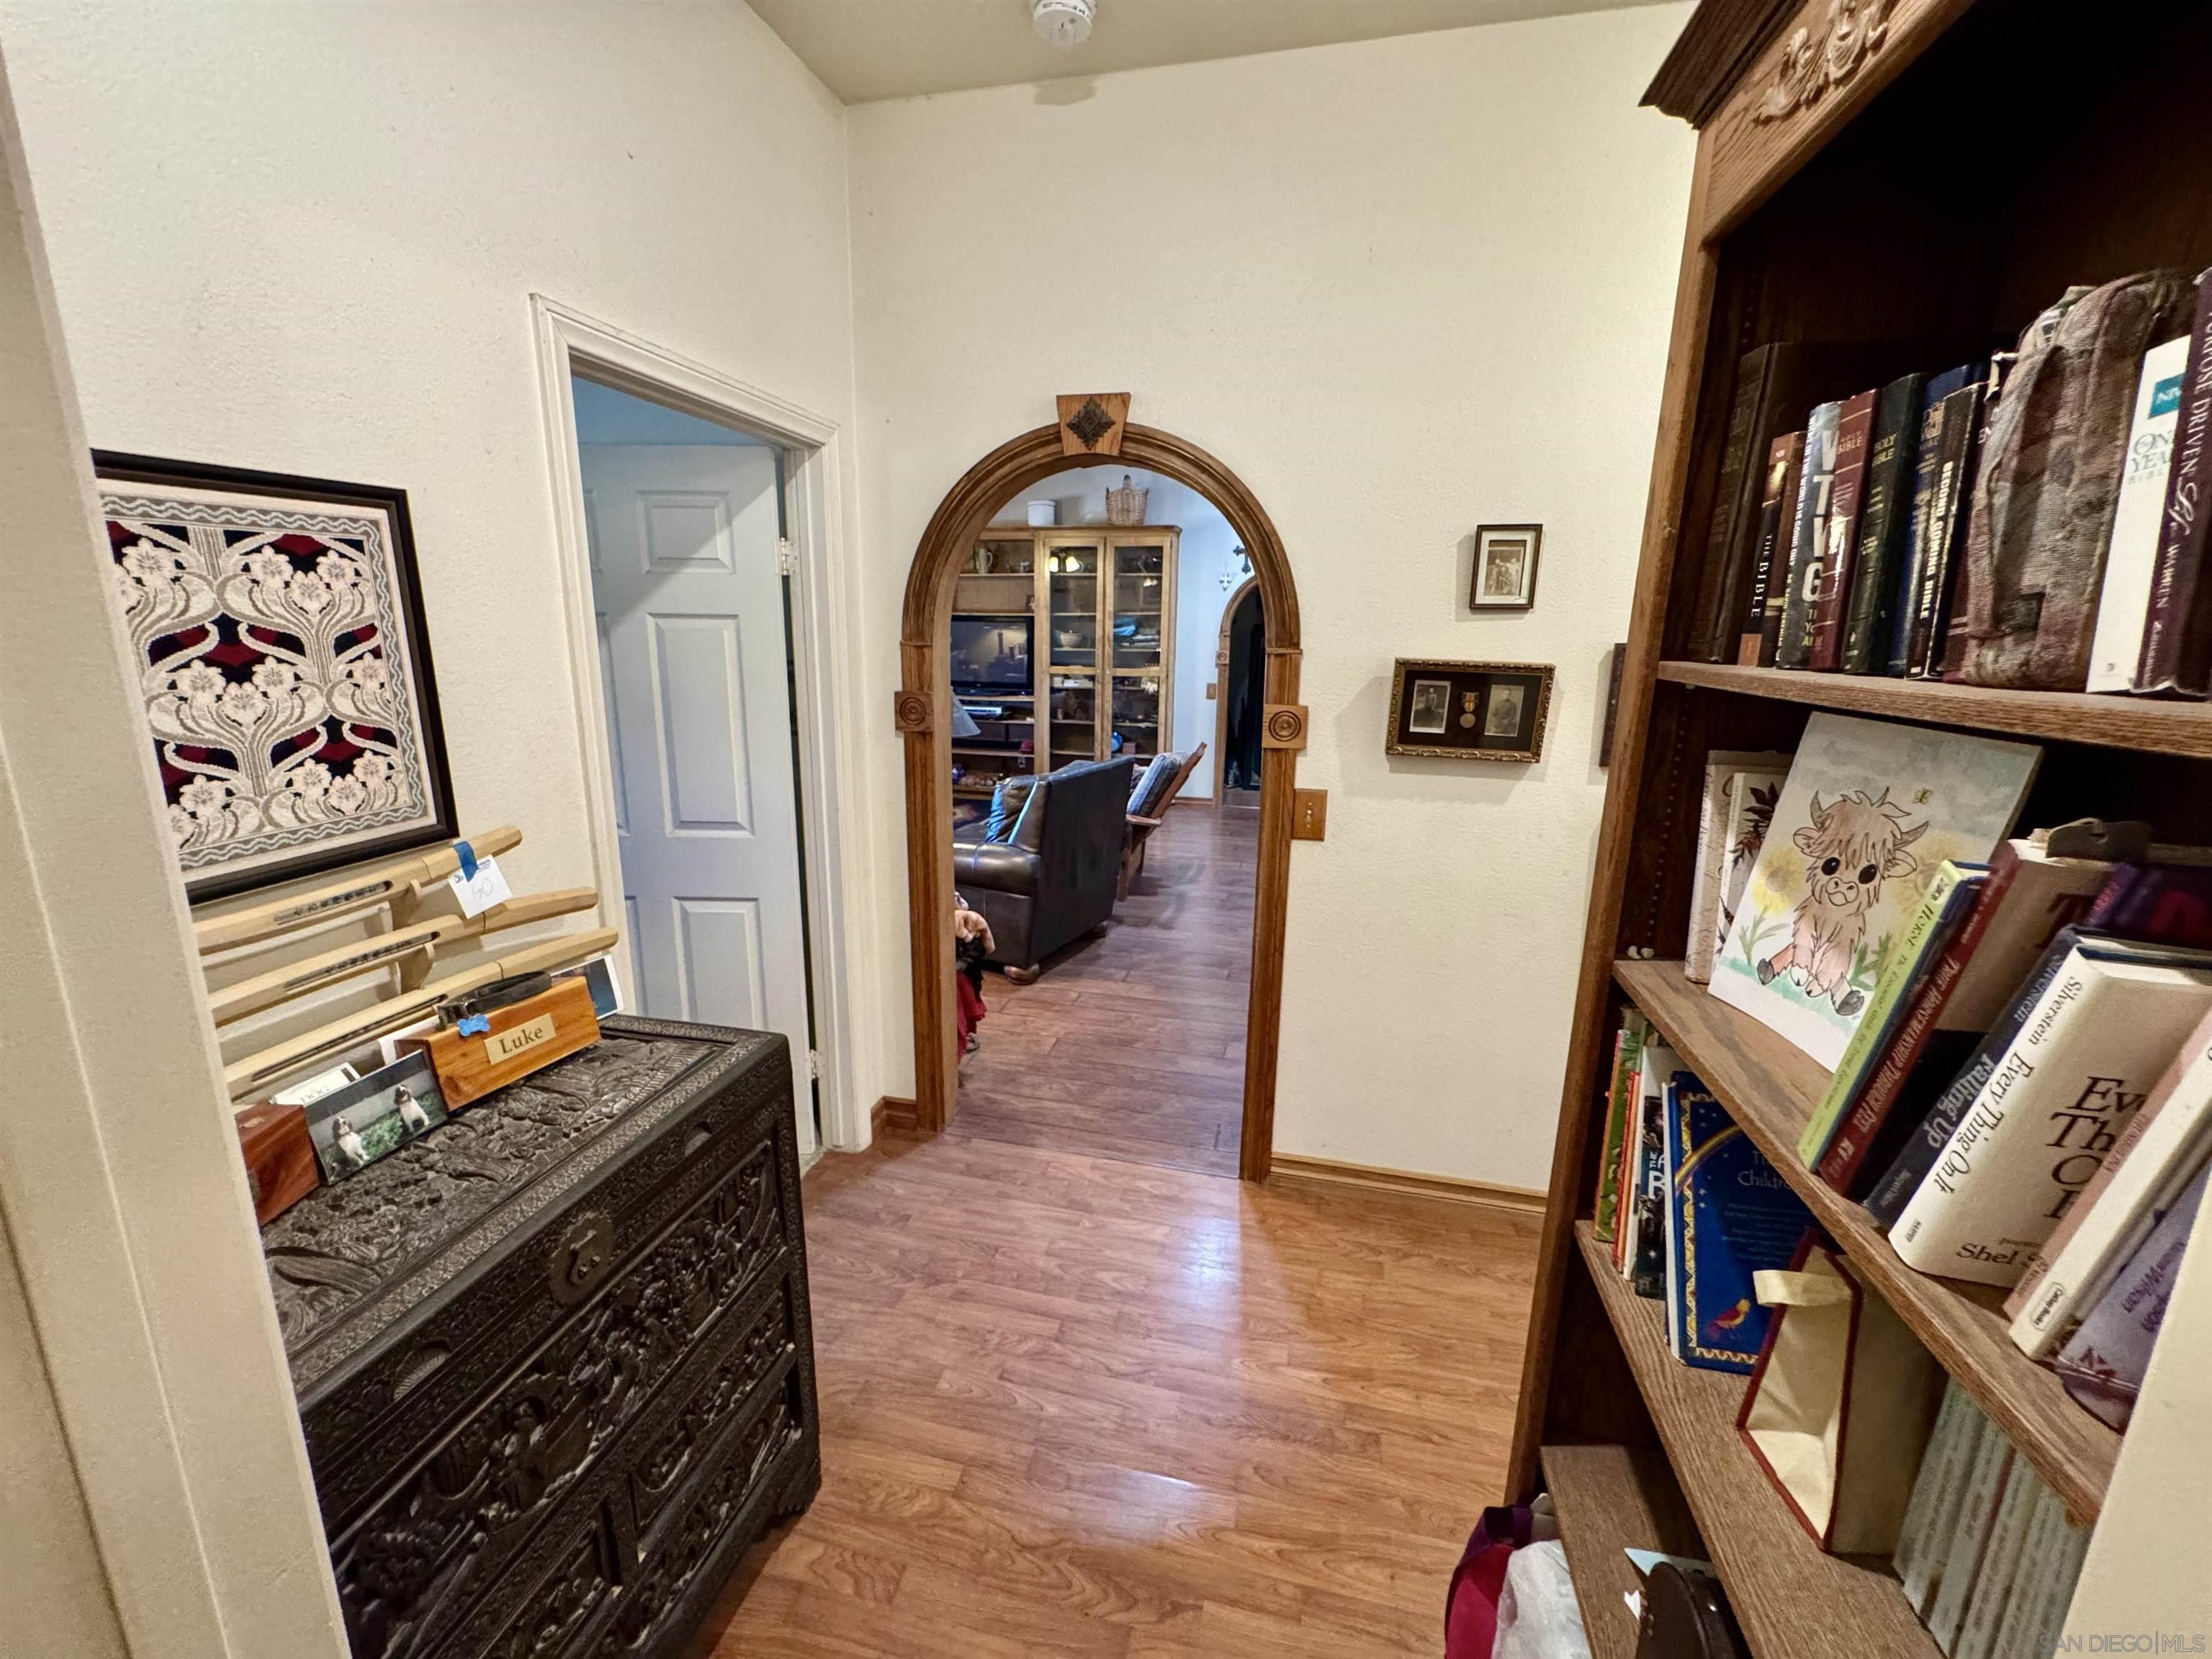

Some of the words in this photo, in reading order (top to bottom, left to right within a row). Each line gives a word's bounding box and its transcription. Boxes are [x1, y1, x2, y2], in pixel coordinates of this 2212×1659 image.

[2180, 397, 2211, 475] DRIVEN
[1936, 460, 1954, 517] SECOND
[1925, 519, 1944, 577] COMING
[1751, 562, 1769, 617] BIBLE
[1919, 579, 1934, 620] BIBLE
[2028, 975, 2083, 1046] Silverstein
[498, 1028, 543, 1054] Luke
[300, 1086, 331, 1104] DOG
[1936, 1053, 1997, 1121] Falling
[1989, 1051, 2035, 1106] Every
[1923, 1116, 1957, 1149] Up
[1956, 1100, 2005, 1154] Thing
[1933, 1172, 1955, 1194] It
[1941, 1150, 1971, 1177] On
[1956, 1242, 2021, 1266] Shel
